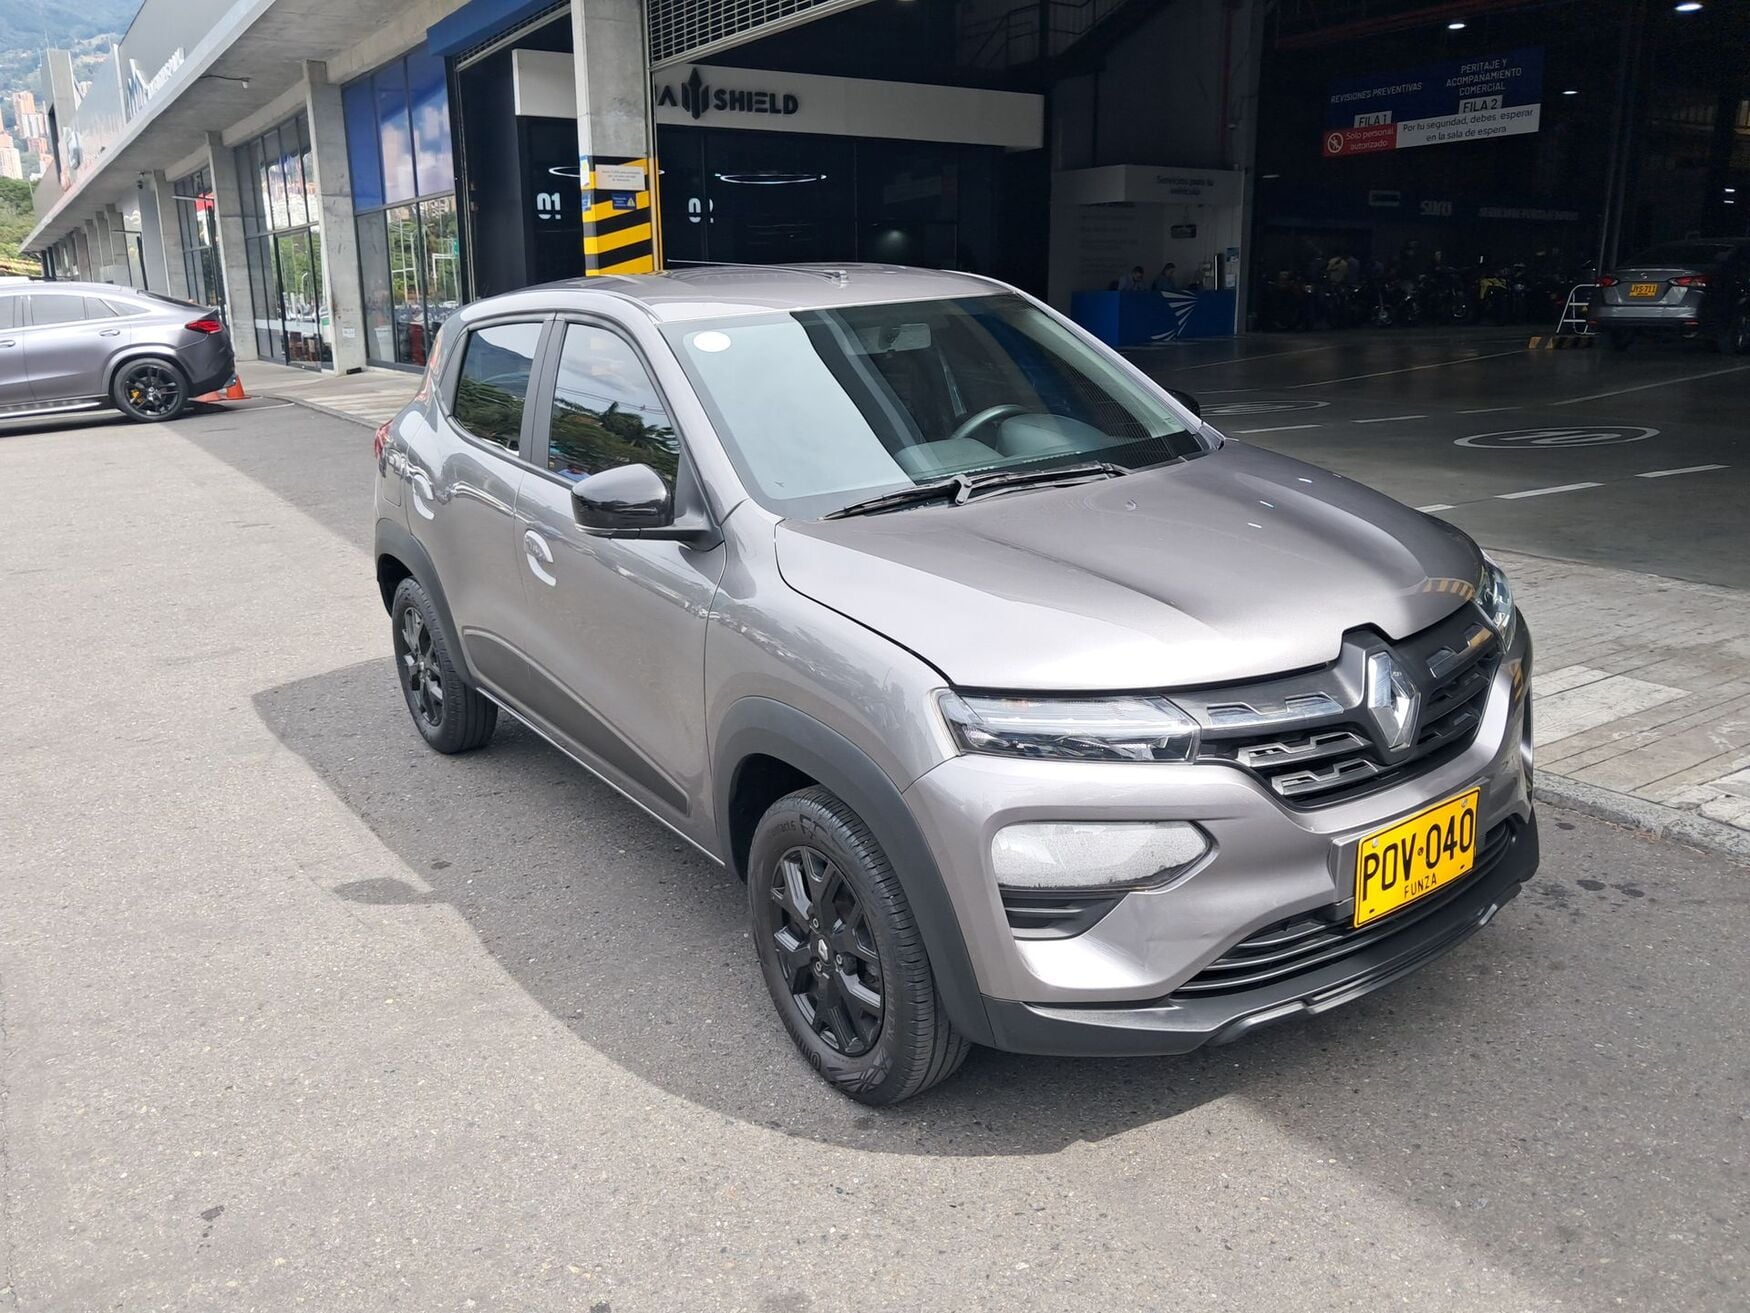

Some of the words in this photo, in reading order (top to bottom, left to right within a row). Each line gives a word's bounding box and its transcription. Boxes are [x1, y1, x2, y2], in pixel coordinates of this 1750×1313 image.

[1461, 58, 1501, 74] PERITAJE
[1502, 57, 1508, 68] Y
[1330, 90, 1371, 104] REVISIONES
[1371, 81, 1423, 97] PREVENTIVAS
[1459, 81, 1506, 96] COMERCIAL
[713, 88, 799, 115] SHIELD
[1463, 100, 1488, 113] FILA
[1491, 98, 1498, 109] 2
[1358, 114, 1380, 127] FILA
[1403, 123, 1415, 132] Por
[1417, 121, 1424, 131] tu
[1470, 113, 1496, 124] debes
[1500, 109, 1534, 121] esperar
[1346, 131, 1361, 140] Solo
[1362, 127, 1394, 139] personal
[1426, 134, 1436, 142] en
[1438, 131, 1445, 141] la
[1447, 128, 1463, 139] sala
[1464, 127, 1475, 137] de
[1478, 125, 1506, 137] espera
[1350, 139, 1388, 150] autorizado
[536, 192, 562, 220] 01
[1404, 872, 1438, 899] FUNZA
